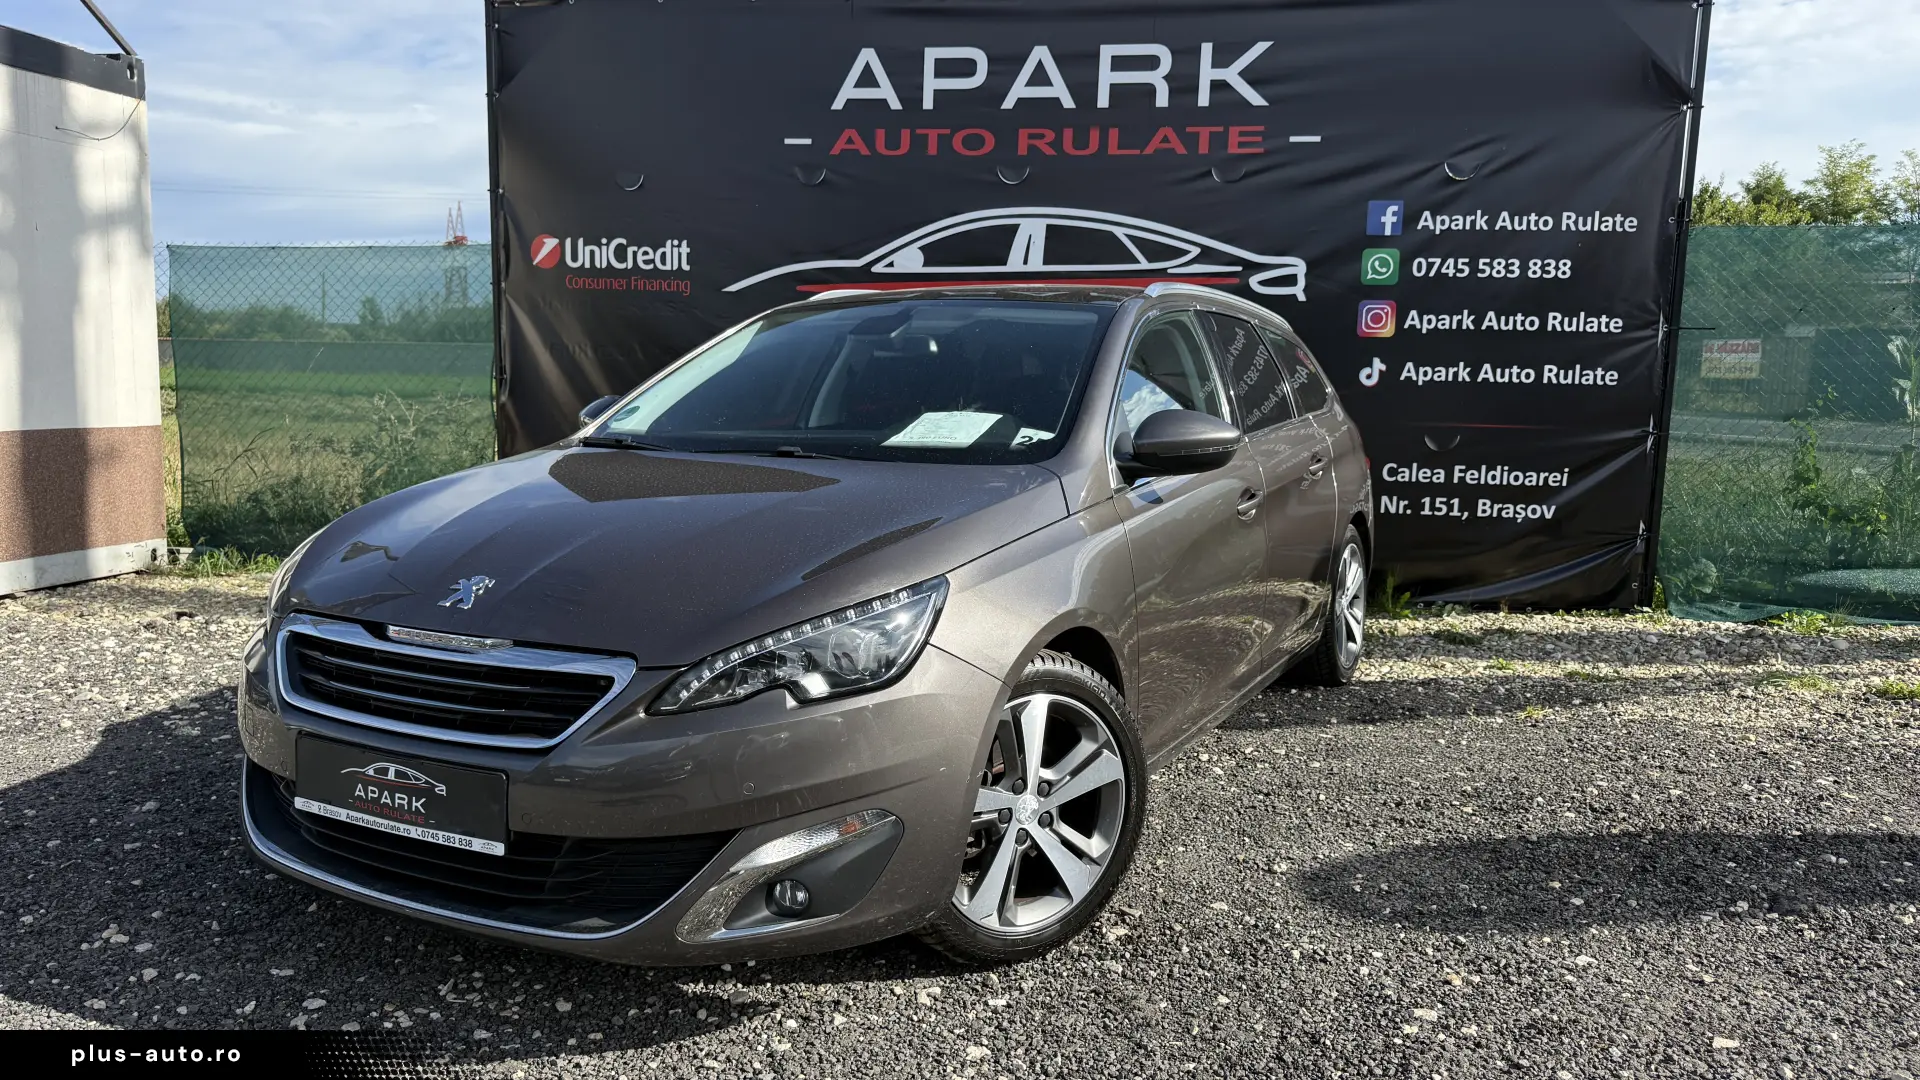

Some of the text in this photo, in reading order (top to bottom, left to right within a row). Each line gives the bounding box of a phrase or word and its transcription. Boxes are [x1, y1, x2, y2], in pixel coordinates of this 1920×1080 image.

[830, 41, 1275, 110] APARK
[829, 125, 1266, 156] AUTO RULATE
[1416, 210, 1639, 235] Apark Auto Rulate
[564, 236, 692, 272] UniCredit
[1411, 257, 1573, 279] 0745 583 838
[565, 274, 692, 297] Consumer Financing
[1403, 309, 1624, 334] Apark Auto Rulate
[1400, 361, 1620, 386] Apark Auto Rulate
[1381, 462, 1570, 487] Calea Feldioarei
[1379, 495, 1412, 515] Nr.
[1419, 496, 1469, 520] 151,
[1476, 498, 1557, 523] Brașov
[354, 783, 427, 814] APARK
[354, 800, 425, 824] AUTO RULATE
[345, 812, 412, 836] Aparkautorulate.ro
[421, 829, 440, 842] 0745
[441, 834, 456, 845] 583
[458, 837, 473, 848] 838
